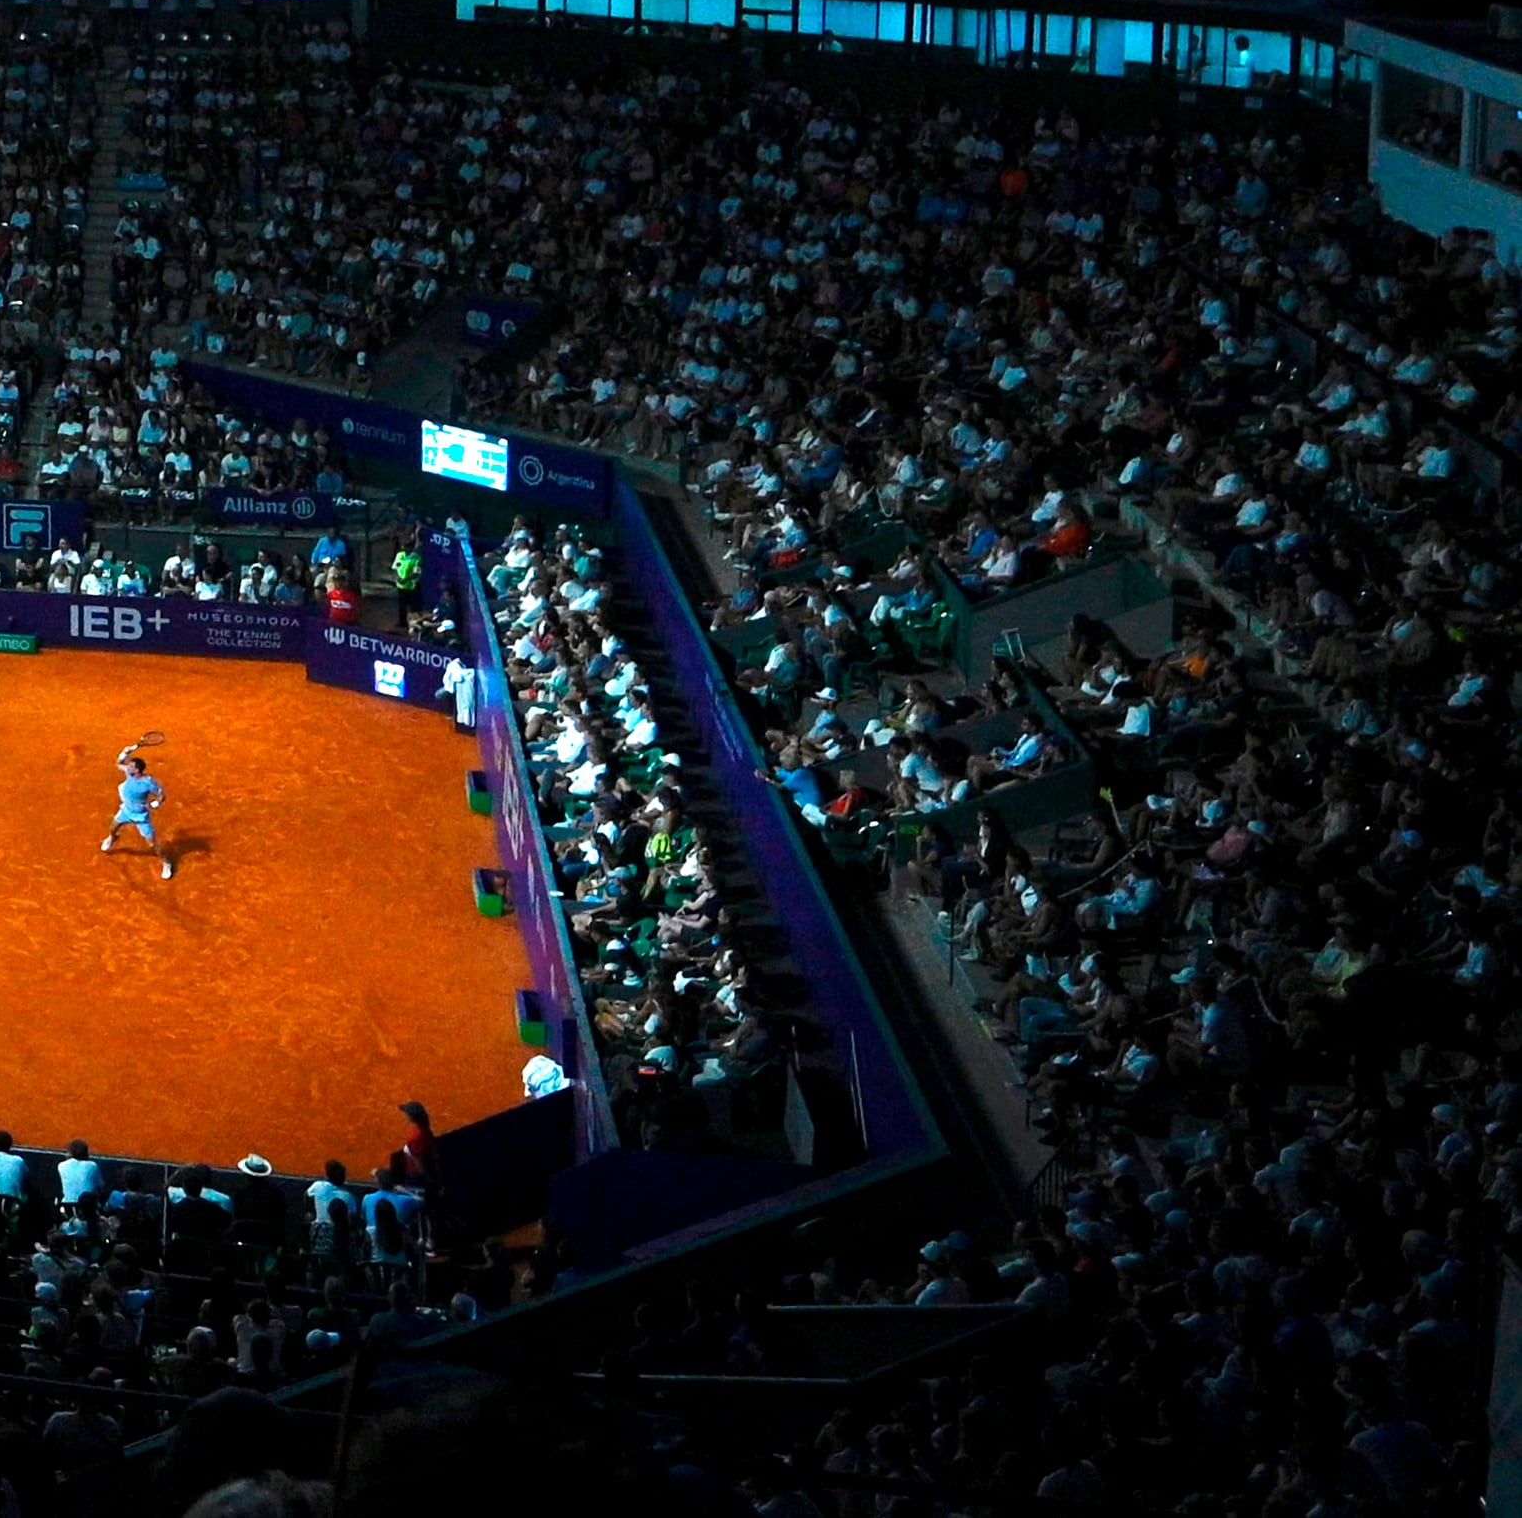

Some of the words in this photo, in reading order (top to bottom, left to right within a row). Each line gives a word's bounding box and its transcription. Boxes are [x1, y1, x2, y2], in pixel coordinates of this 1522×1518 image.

[354, 422, 406, 446] tennium
[547, 469, 596, 491] Argentina
[223, 496, 288, 514] Allianz
[69, 603, 171, 640] IEB+
[206, 637, 282, 649] COLLECTION
[207, 628, 231, 638] THE
[236, 630, 281, 641] TENNIS
